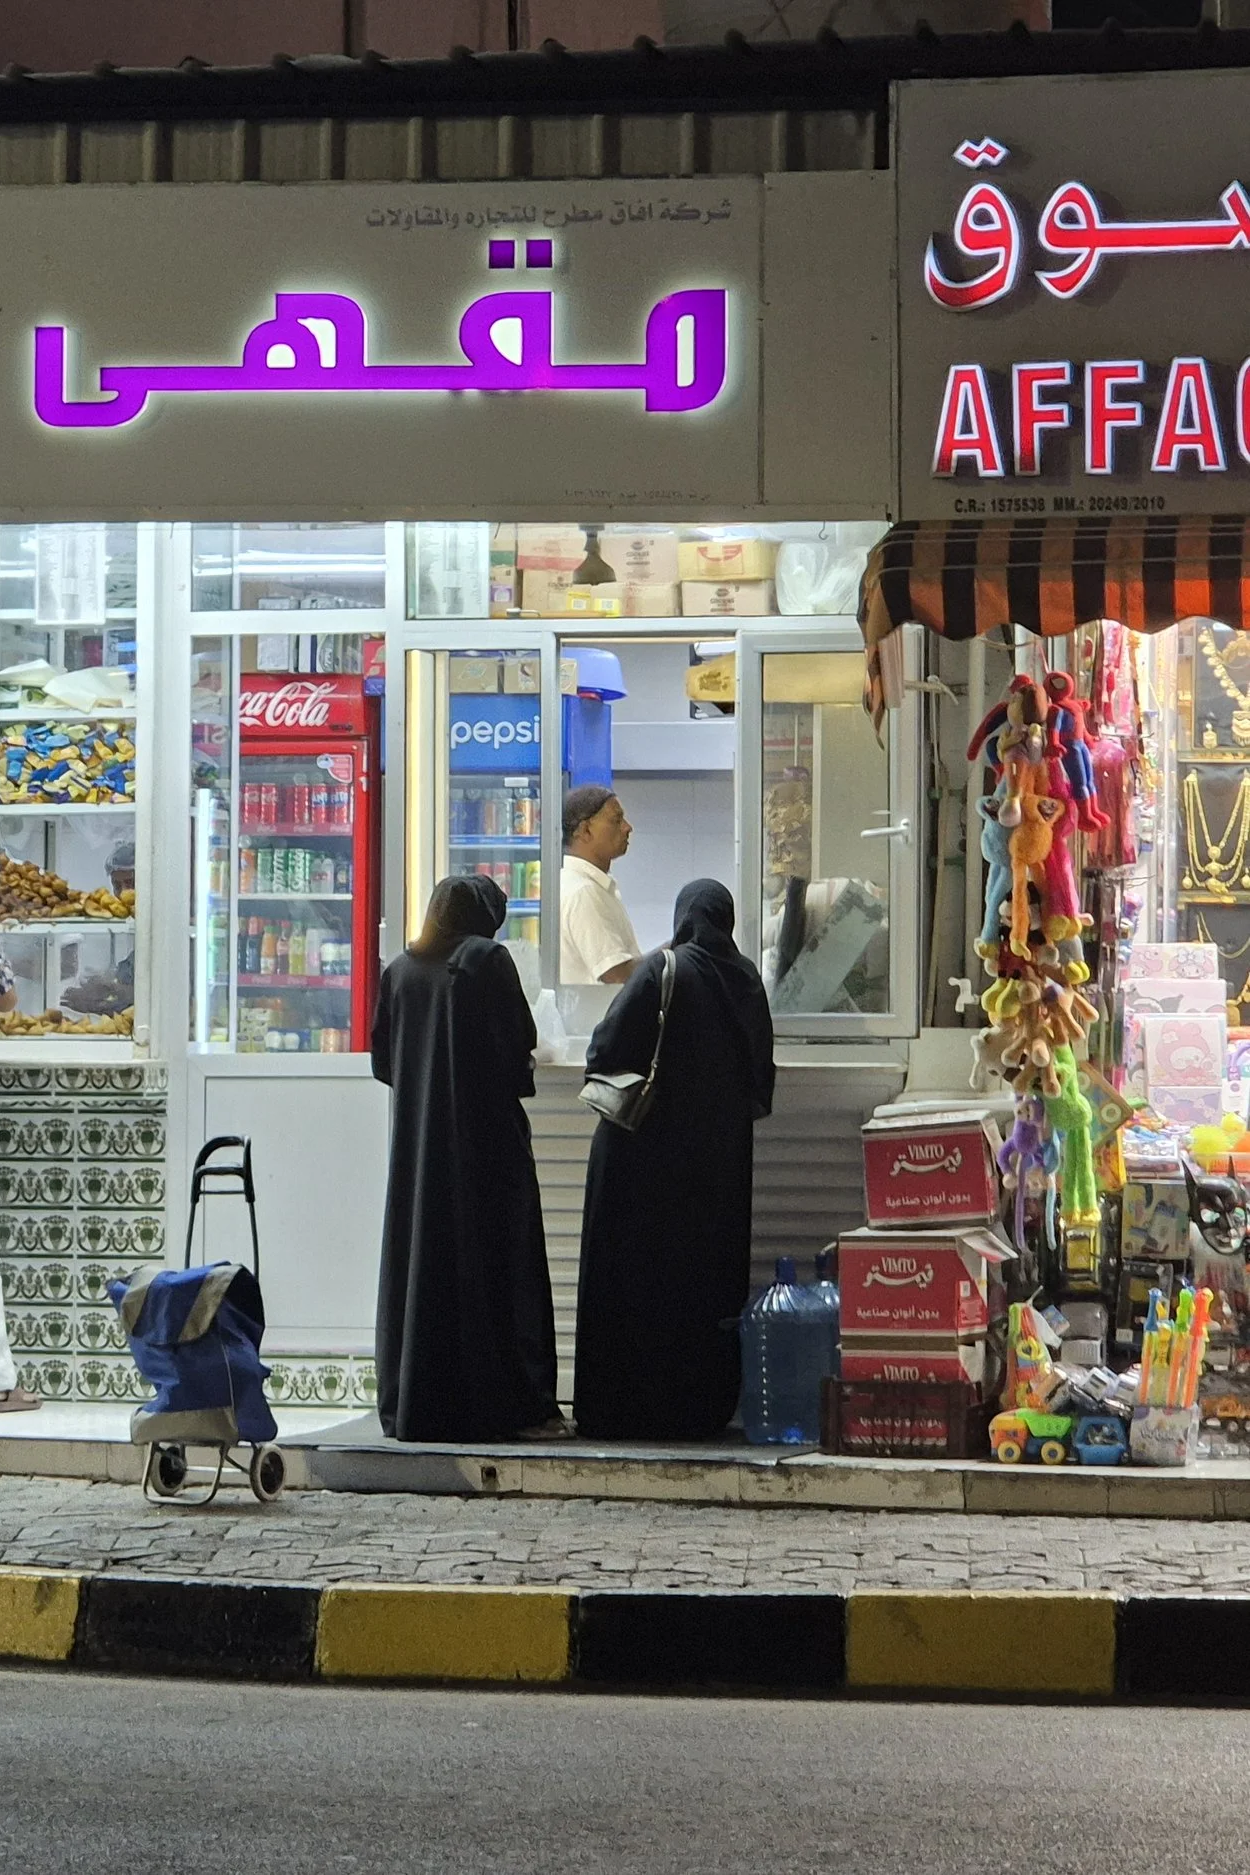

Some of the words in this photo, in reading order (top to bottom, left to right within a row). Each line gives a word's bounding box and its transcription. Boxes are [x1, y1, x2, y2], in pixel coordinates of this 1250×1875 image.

[660, 198, 731, 224] شركة
[34, 239, 727, 428] مقهى
[932, 357, 1250, 477] AFFA
[450, 715, 540, 750] pepsi
[889, 1147, 962, 1177] فيمتو
[907, 1143, 945, 1161] VIMTO
[862, 1263, 934, 1290] فيمتو
[881, 1256, 917, 1274] VIMTO
[883, 1364, 920, 1381] VIMTO
